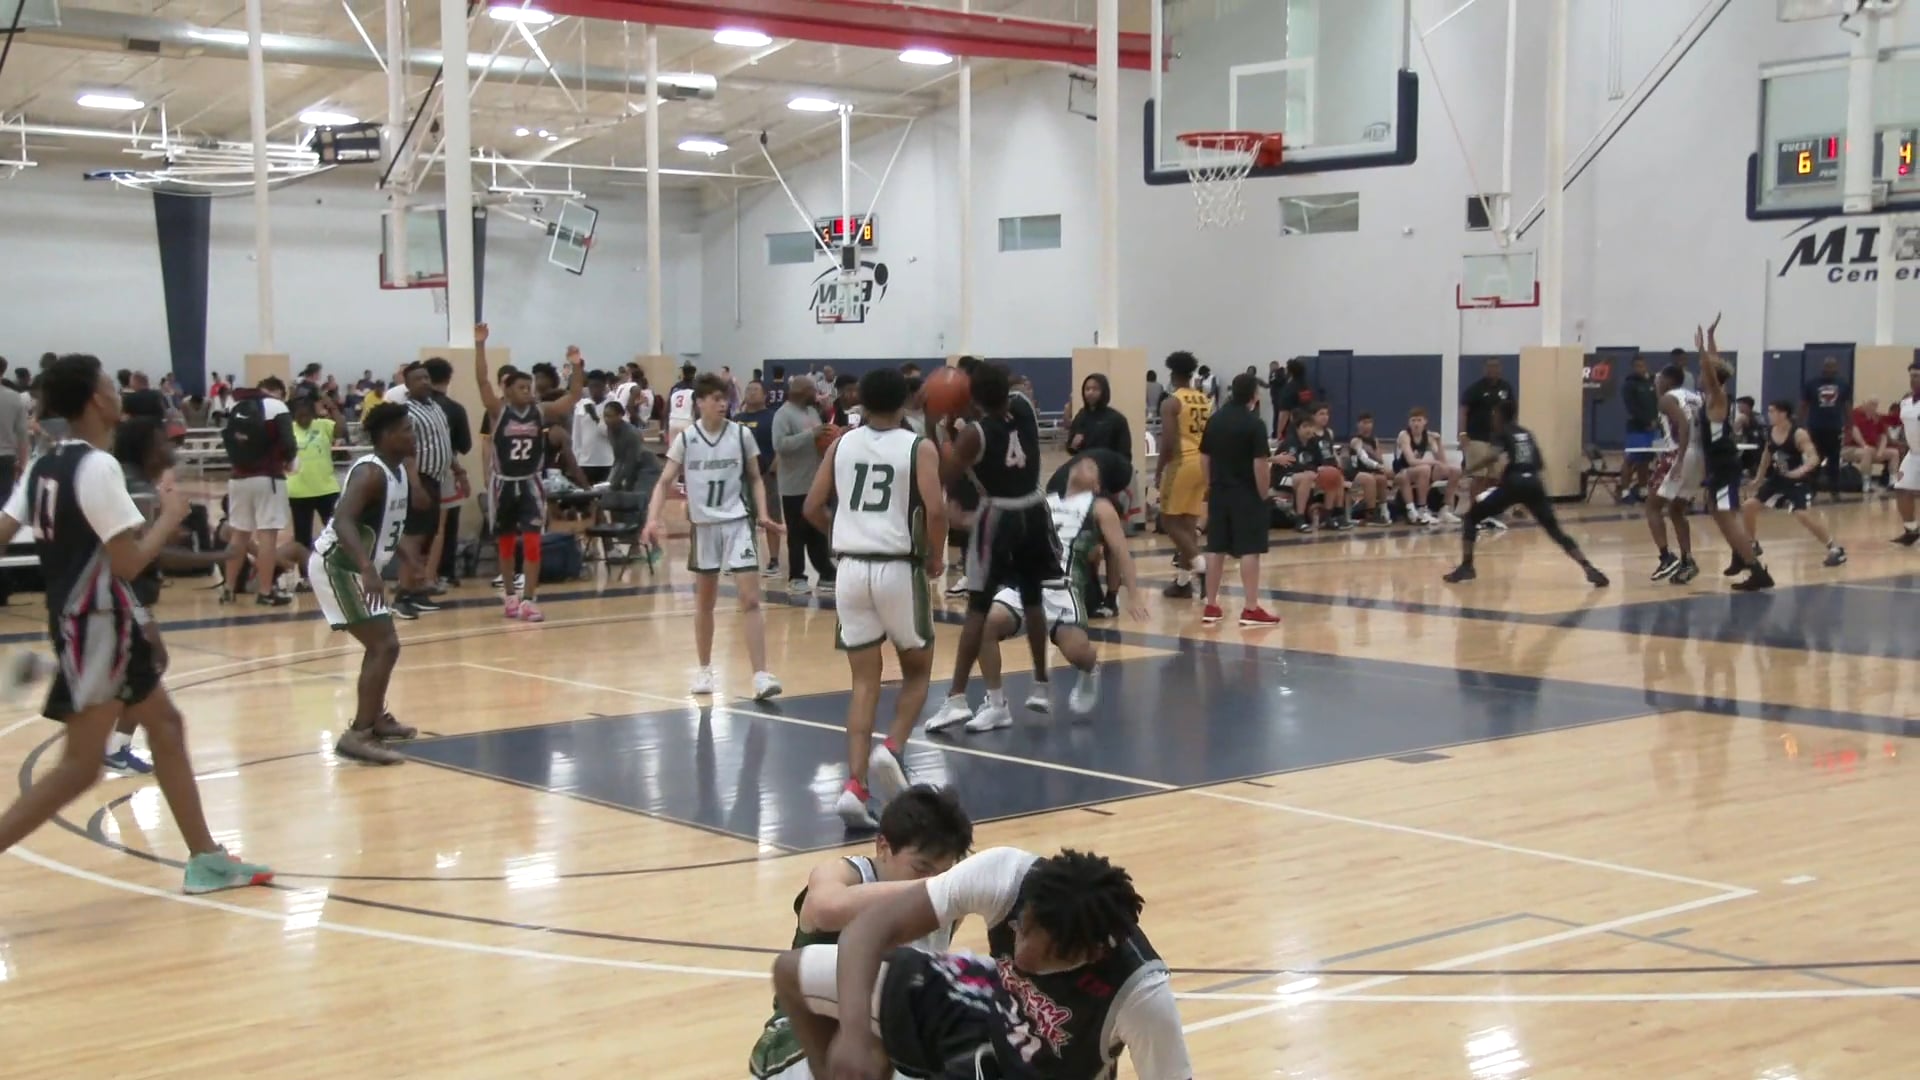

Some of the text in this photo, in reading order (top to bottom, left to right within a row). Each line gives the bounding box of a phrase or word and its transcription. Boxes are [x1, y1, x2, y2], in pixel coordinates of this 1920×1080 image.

[1798, 151, 1812, 174] 6
[1899, 142, 1912, 164] 4
[676, 395, 684, 408] 3
[511, 438, 533, 460] 22
[1005, 430, 1026, 468] 4
[706, 480, 726, 507] 11
[850, 463, 895, 512] 13
